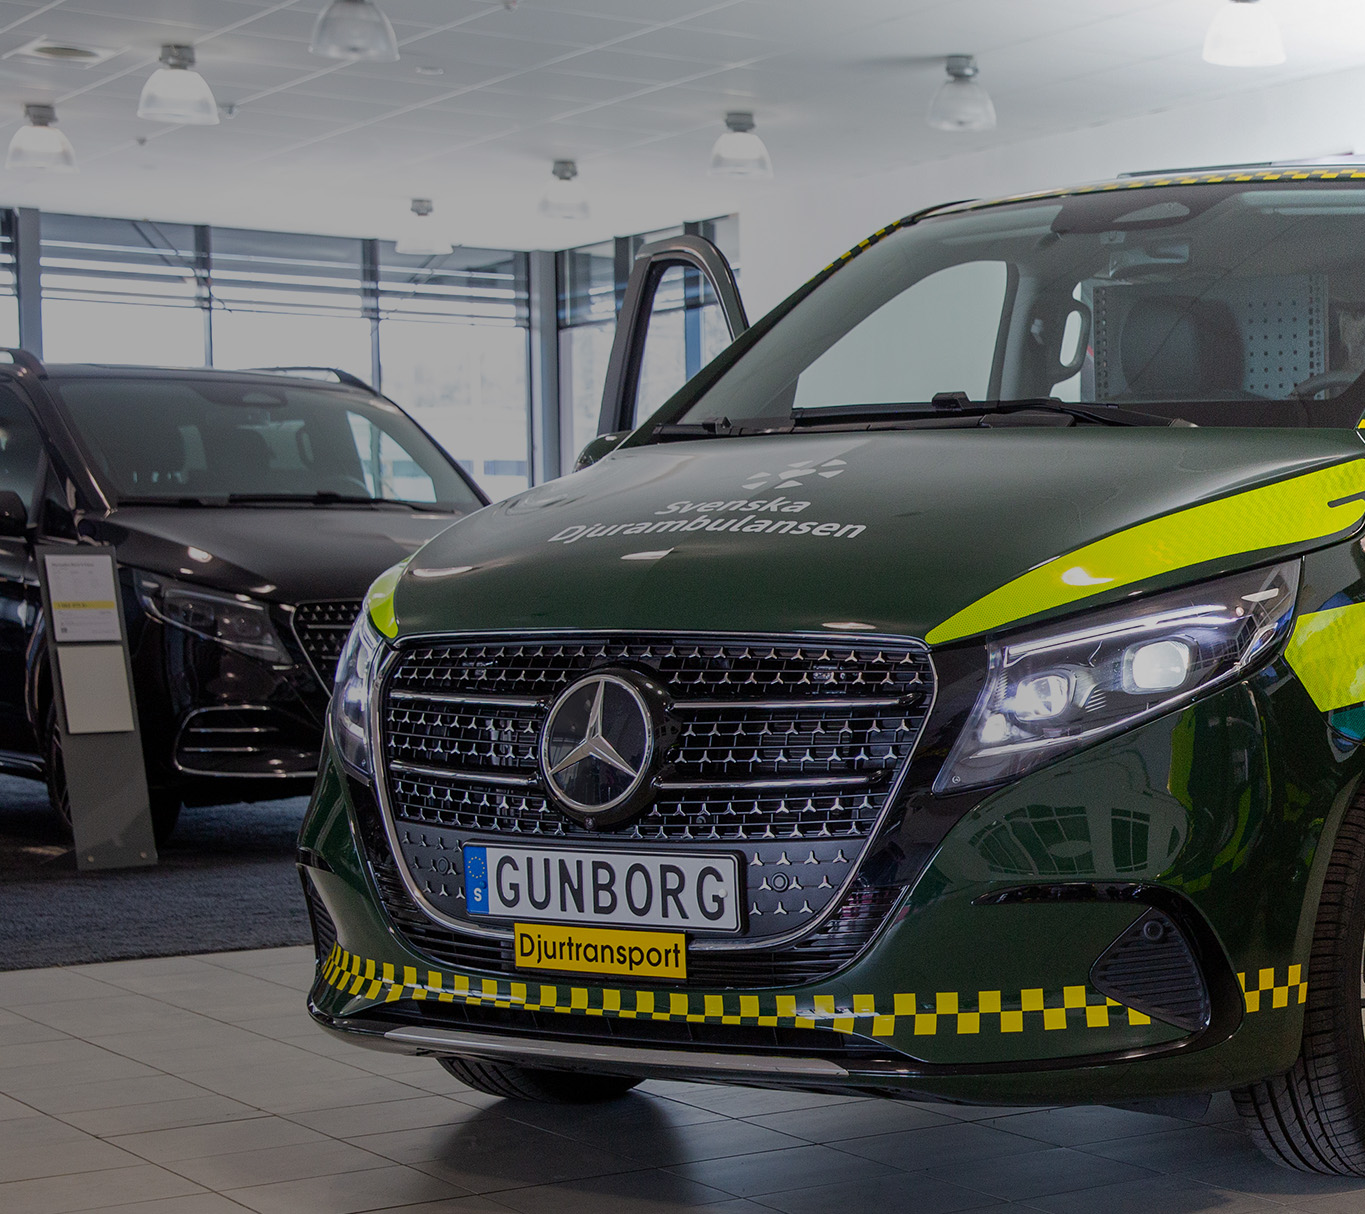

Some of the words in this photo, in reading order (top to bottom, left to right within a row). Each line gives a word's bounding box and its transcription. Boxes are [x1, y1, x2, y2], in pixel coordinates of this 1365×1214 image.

[654, 496, 812, 516] Svenska
[548, 514, 867, 544] Djurambulansen
[473, 887, 483, 902] S
[496, 855, 726, 921] GUNBORG
[519, 933, 681, 971] Djurtransport
